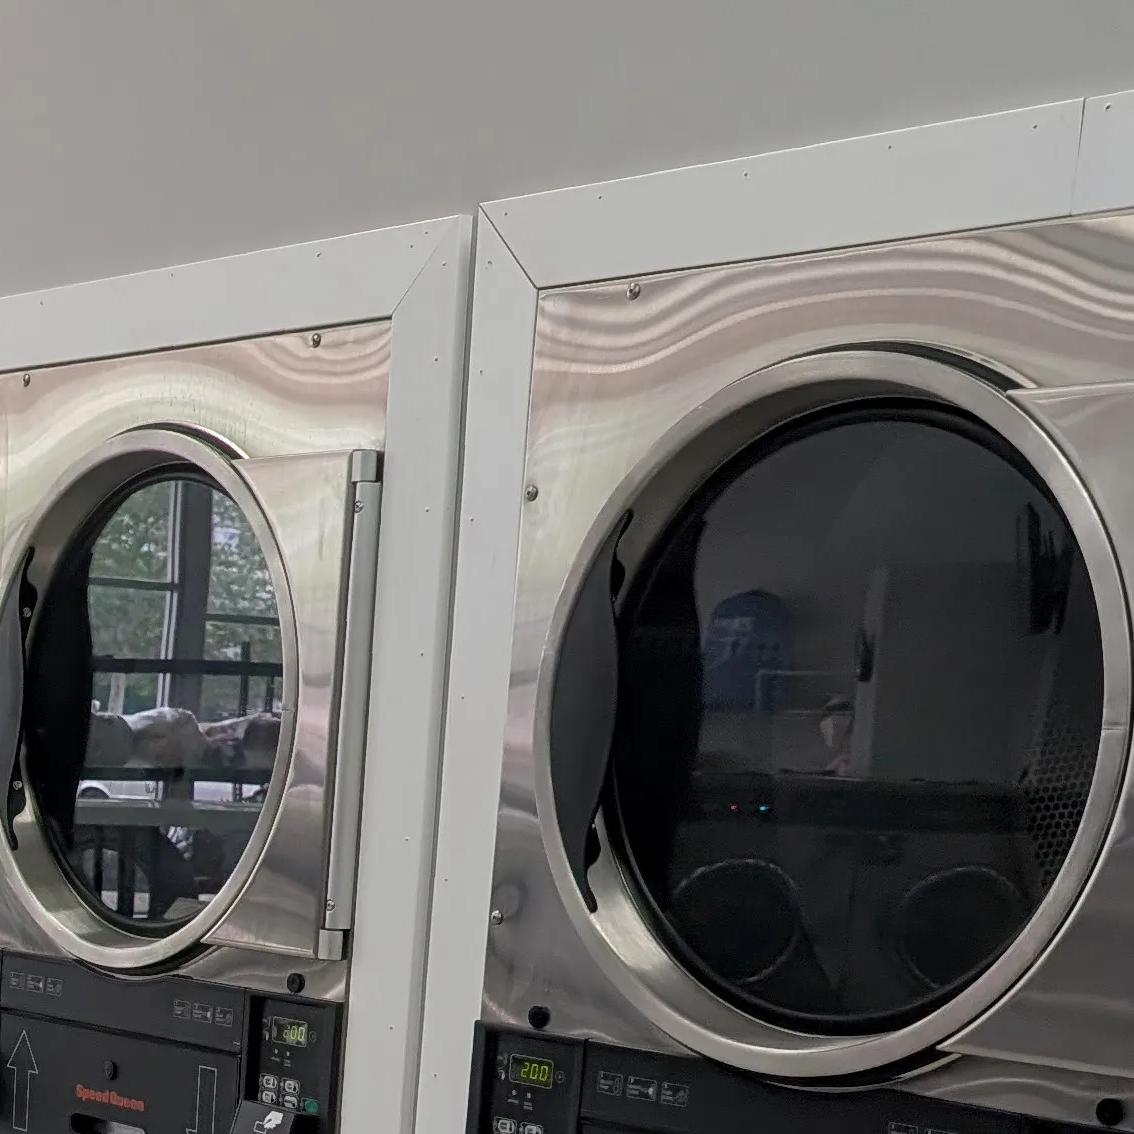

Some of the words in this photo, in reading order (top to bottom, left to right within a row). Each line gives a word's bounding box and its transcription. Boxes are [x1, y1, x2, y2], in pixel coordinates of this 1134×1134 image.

[520, 1062, 549, 1082] 200
[75, 1083, 109, 1102] Speed
[109, 1091, 145, 1112] Queen
